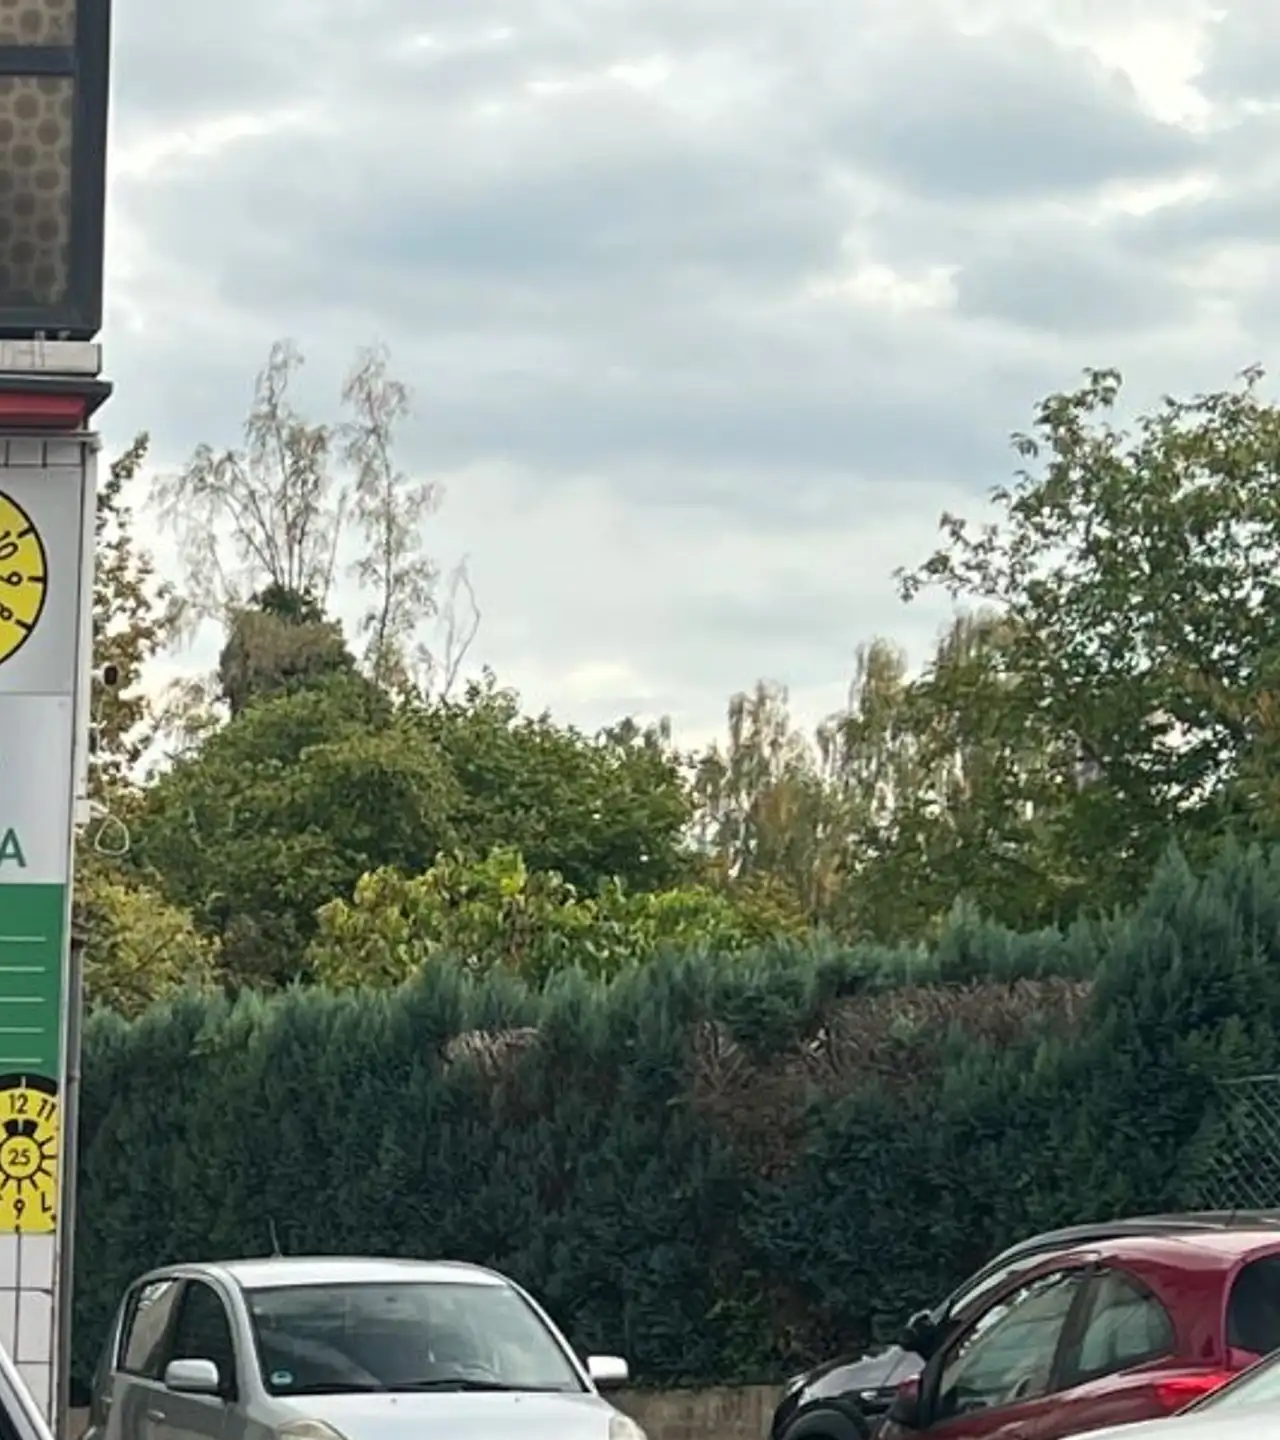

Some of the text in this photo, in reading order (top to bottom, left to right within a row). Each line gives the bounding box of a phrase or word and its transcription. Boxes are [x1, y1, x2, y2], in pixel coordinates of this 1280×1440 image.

[9, 1093, 28, 1114] 12
[37, 1098, 57, 1122] 11
[8, 1148, 31, 1166] 25
[13, 1197, 25, 1219] 6
[41, 1192, 52, 1213] 7
